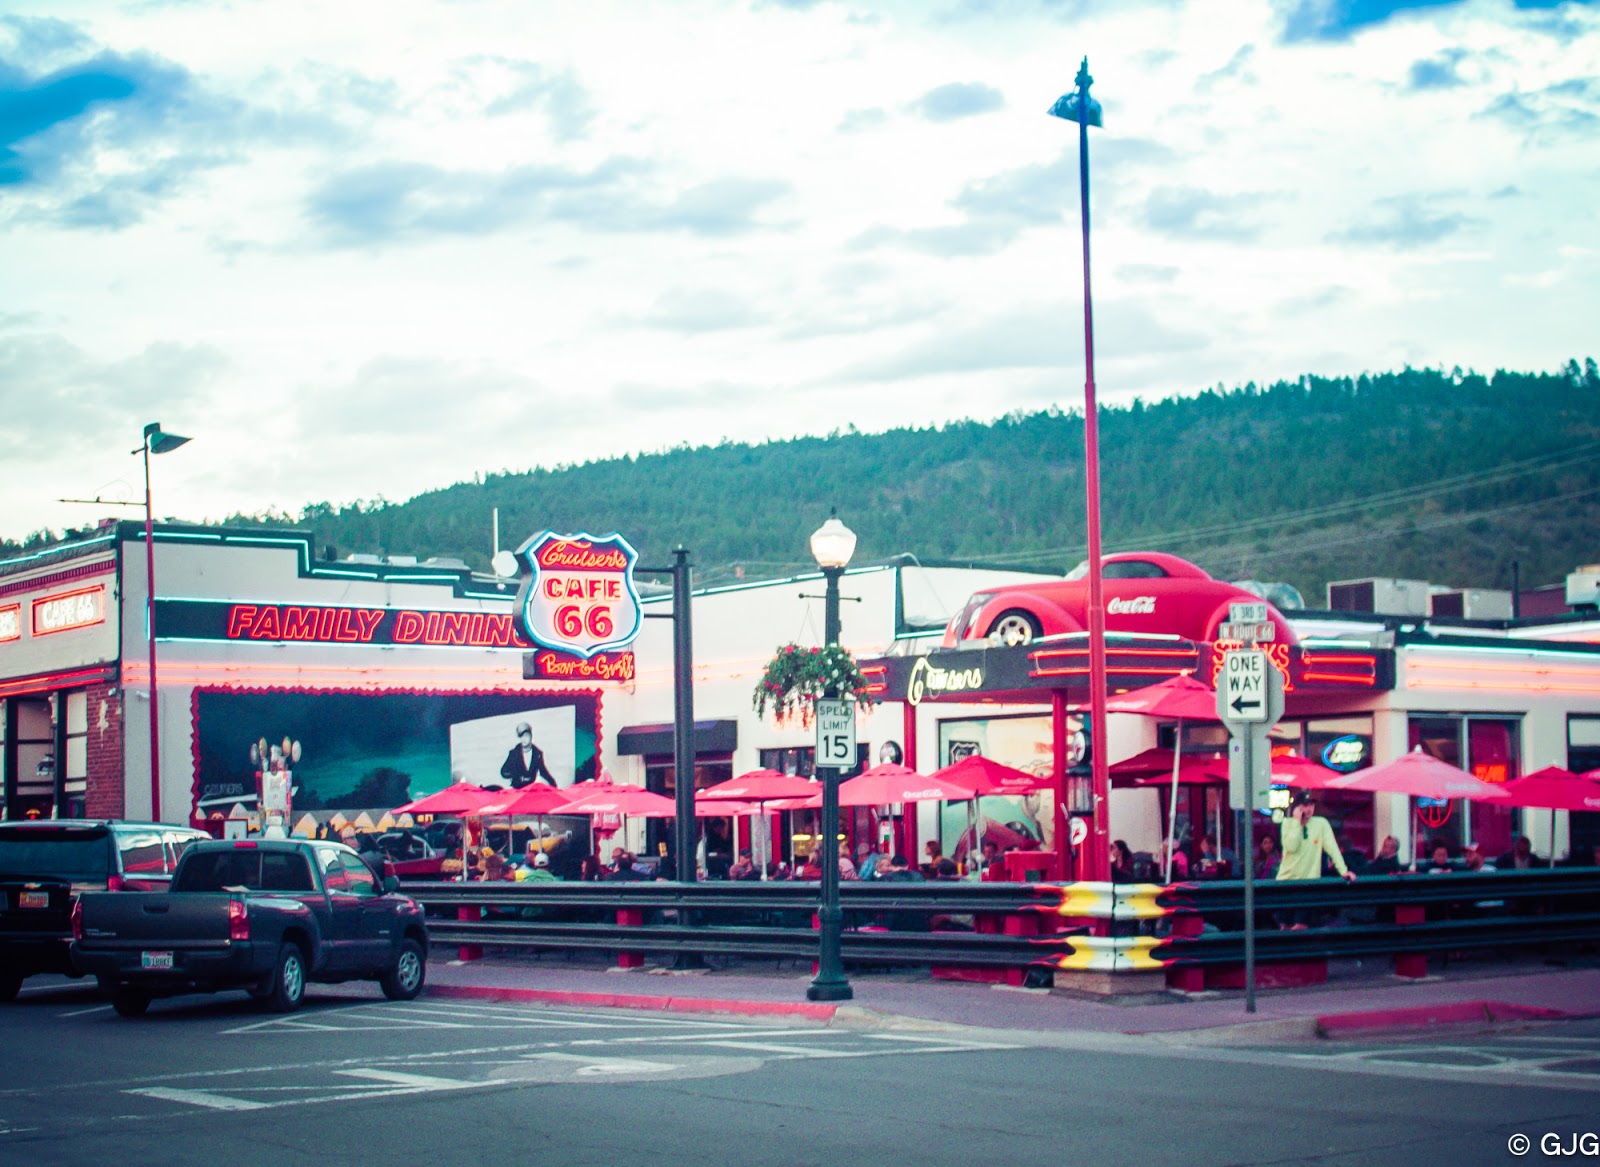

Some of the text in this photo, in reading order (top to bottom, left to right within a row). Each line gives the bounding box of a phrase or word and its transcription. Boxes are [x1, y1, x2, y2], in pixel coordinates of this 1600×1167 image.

[543, 578, 621, 601] CAFE
[228, 605, 386, 641] FAMILY
[553, 603, 615, 640] 66
[1212, 639, 1290, 668] SKS
[1230, 656, 1260, 672] ONE
[1229, 675, 1261, 692] WAY
[823, 720, 849, 730] LIMIT
[823, 734, 849, 758] 15
